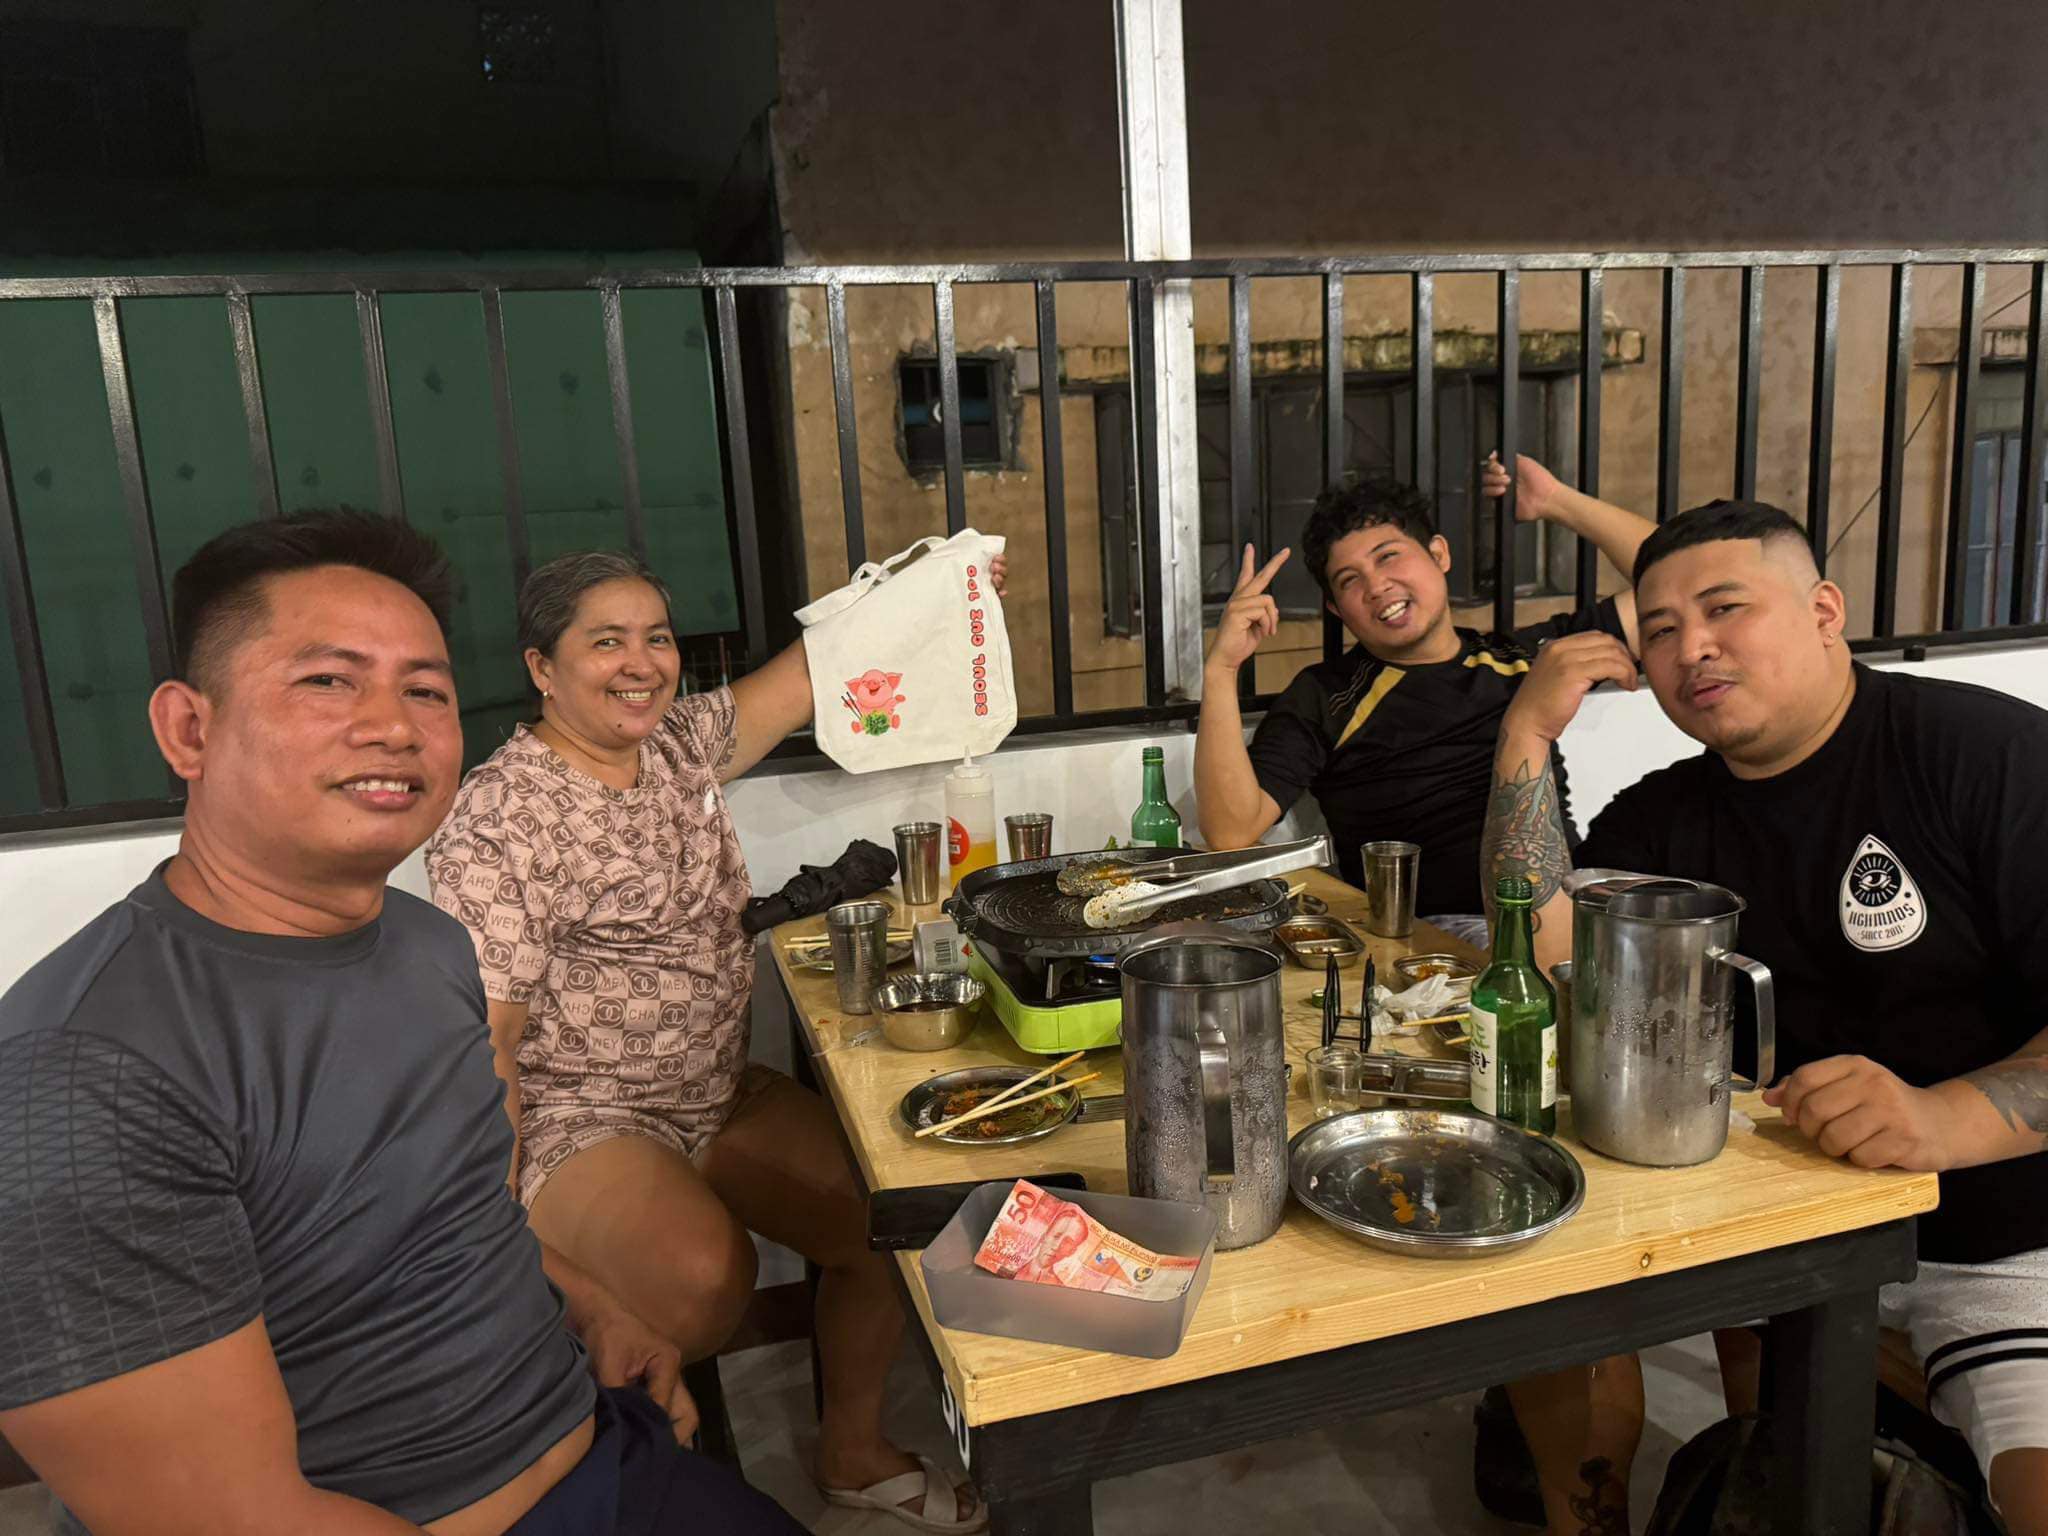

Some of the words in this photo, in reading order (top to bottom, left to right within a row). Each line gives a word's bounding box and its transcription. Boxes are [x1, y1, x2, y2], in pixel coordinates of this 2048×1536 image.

[972, 653, 987, 716] SEOUL
[491, 915, 520, 932] WEY
[1861, 929, 1883, 940] SINCE
[1885, 925, 1903, 939] 2011
[628, 1007, 657, 1021] CHA
[591, 1036, 619, 1049] WEY
[1007, 1191, 1036, 1224] 50
